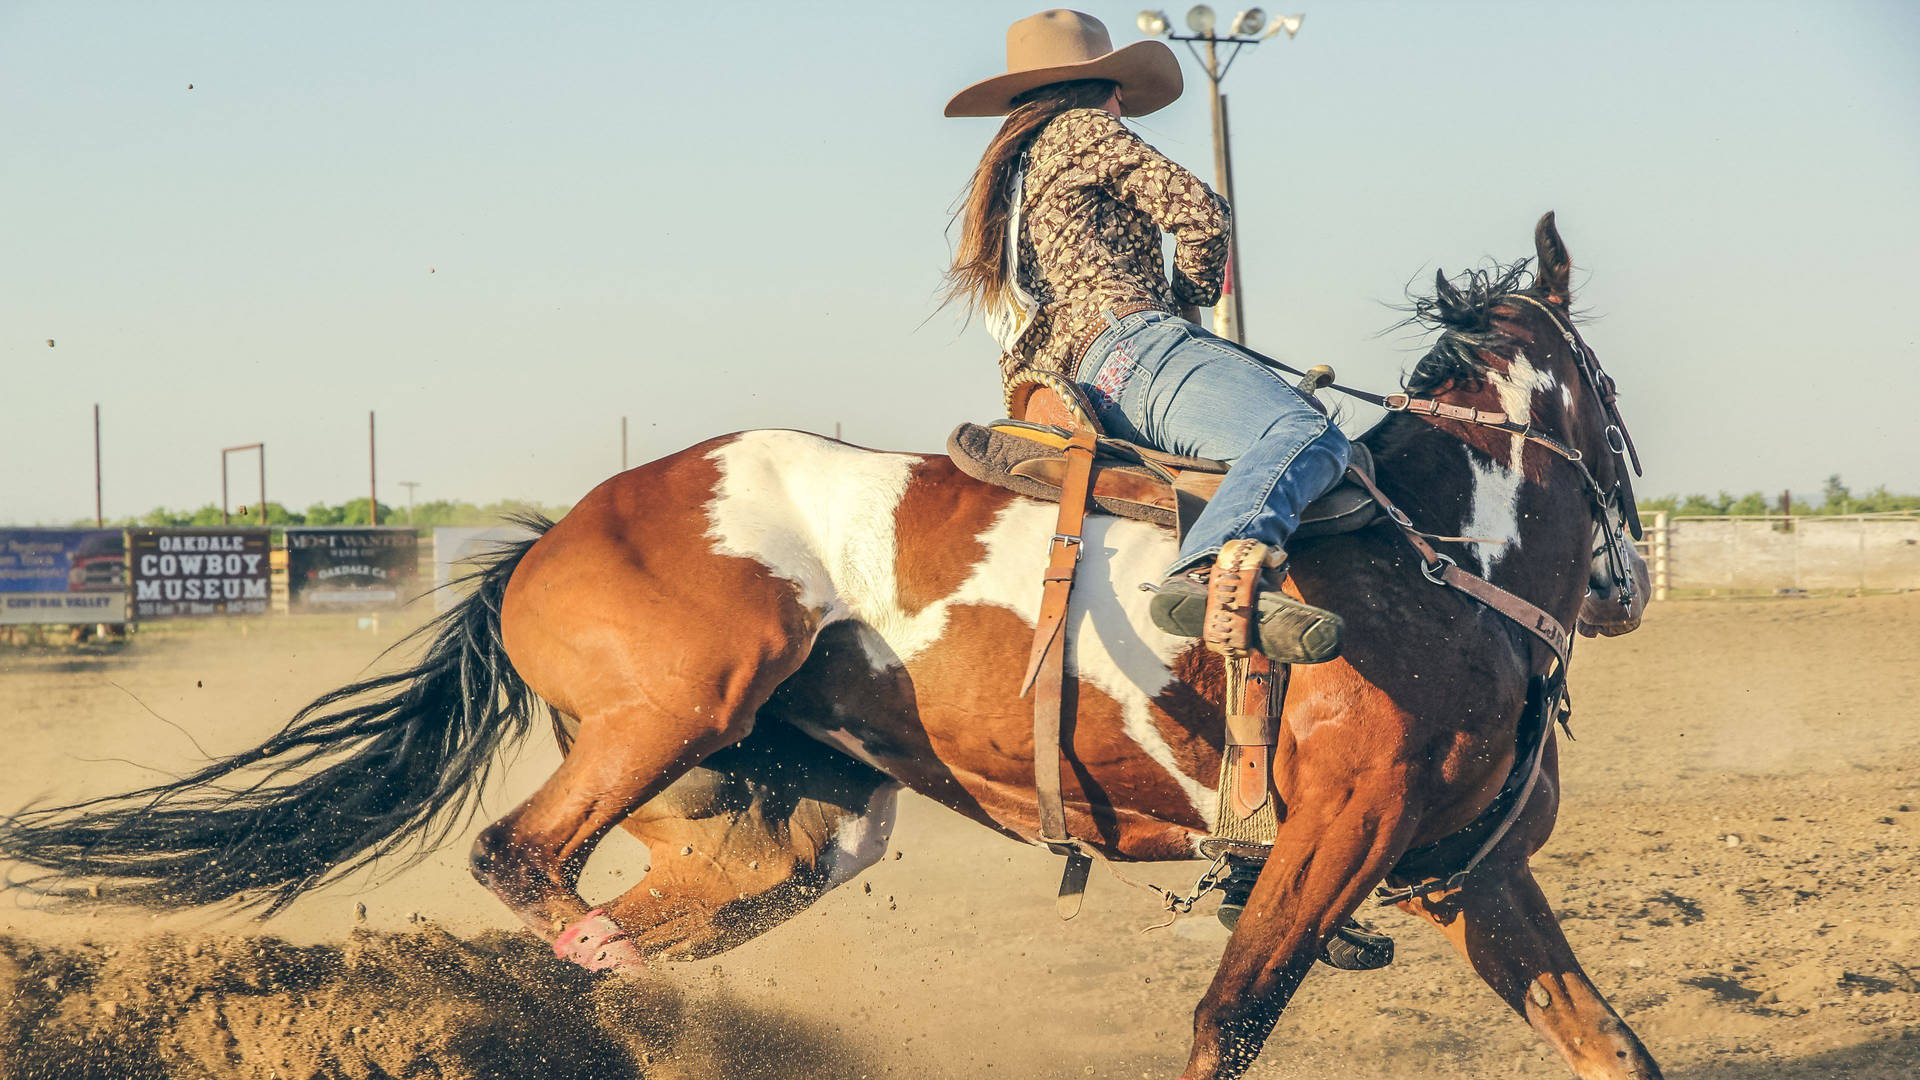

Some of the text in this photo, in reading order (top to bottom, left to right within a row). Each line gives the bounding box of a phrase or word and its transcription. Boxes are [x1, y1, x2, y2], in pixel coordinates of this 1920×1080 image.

[159, 536, 244, 552] OAKDALE
[141, 554, 262, 576] COWBOY
[318, 565, 369, 579] OAKDALE
[135, 578, 267, 600] MUSEUM
[66, 597, 111, 608] VALLEY
